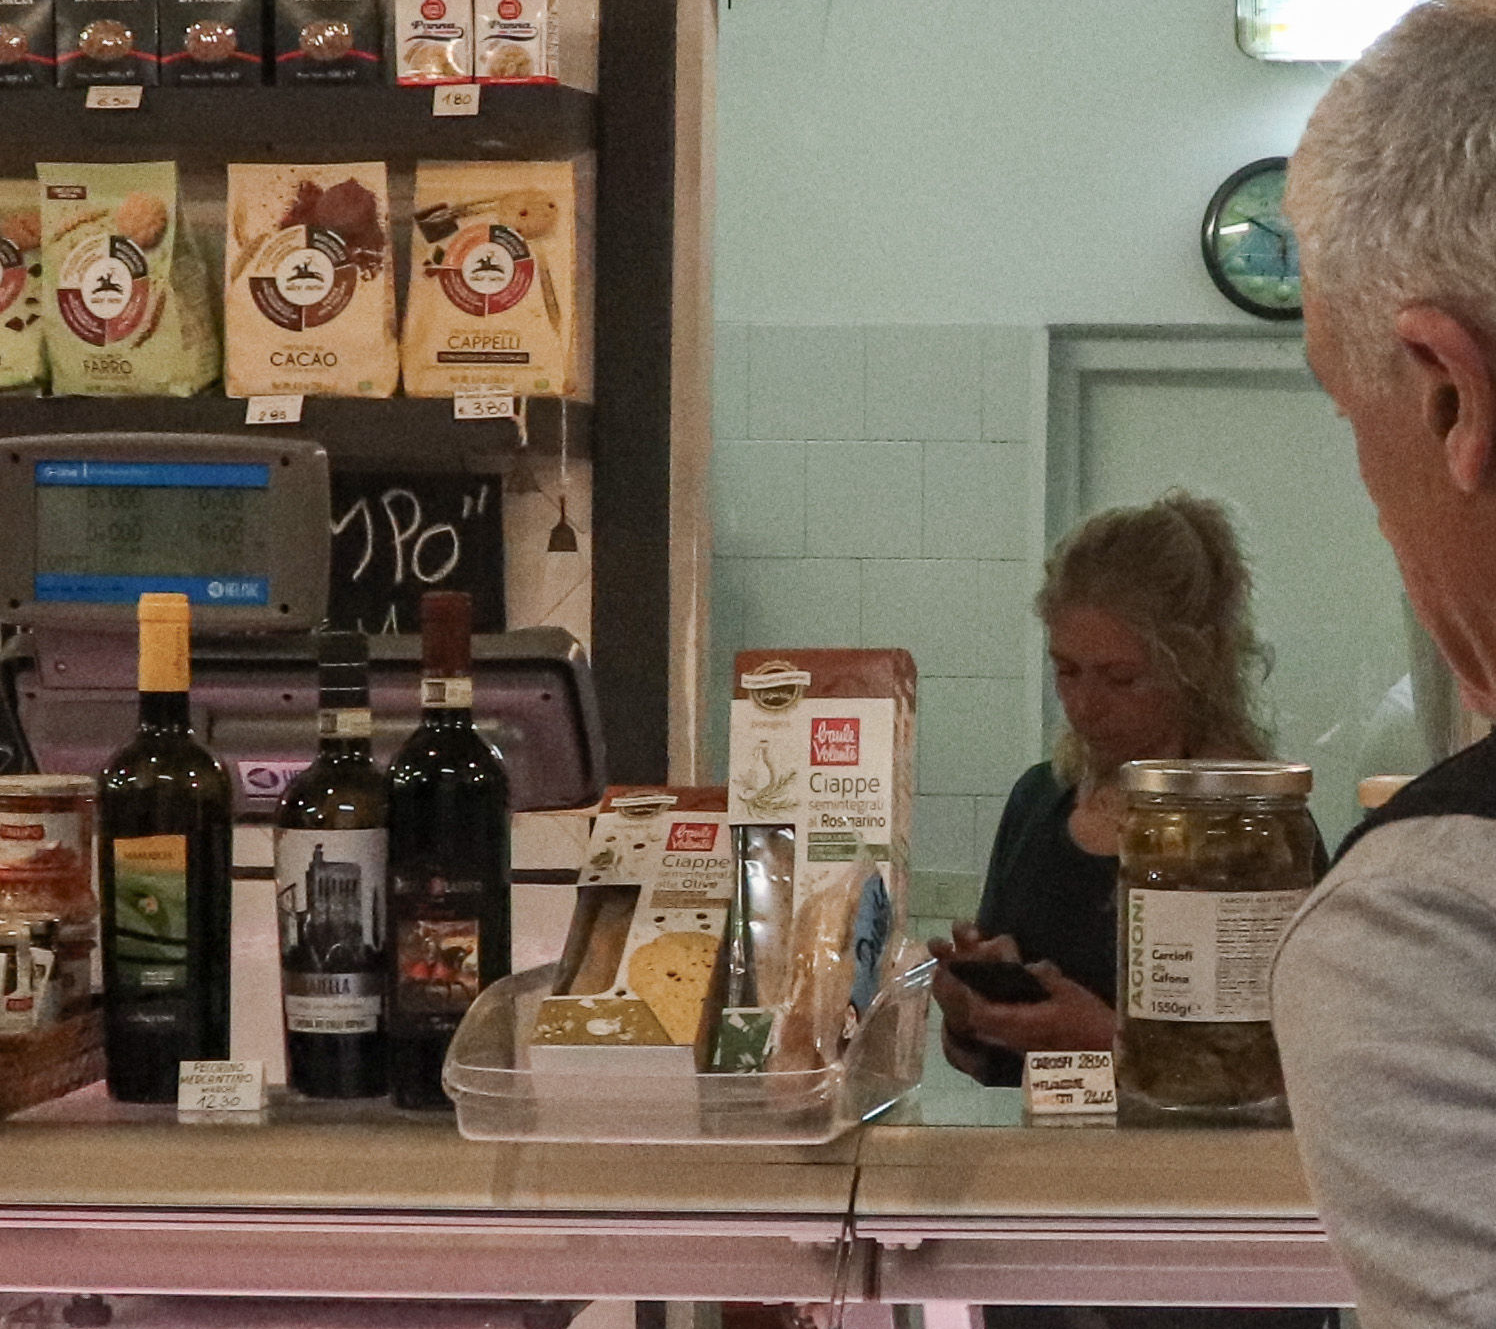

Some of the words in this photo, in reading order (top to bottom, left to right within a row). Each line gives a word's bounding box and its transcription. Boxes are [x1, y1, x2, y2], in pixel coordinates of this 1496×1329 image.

[446, 335, 521, 352] CAPPELLI
[269, 351, 338, 367] CACAO
[809, 772, 881, 800] Ciappe
[808, 800, 884, 816] semintegrali
[820, 813, 886, 829] Rosmarino
[661, 854, 731, 874] Ciappe
[1130, 894, 1145, 1011] AGNONI
[1151, 949, 1195, 963] Carciofi
[1151, 972, 1191, 985] Cafona
